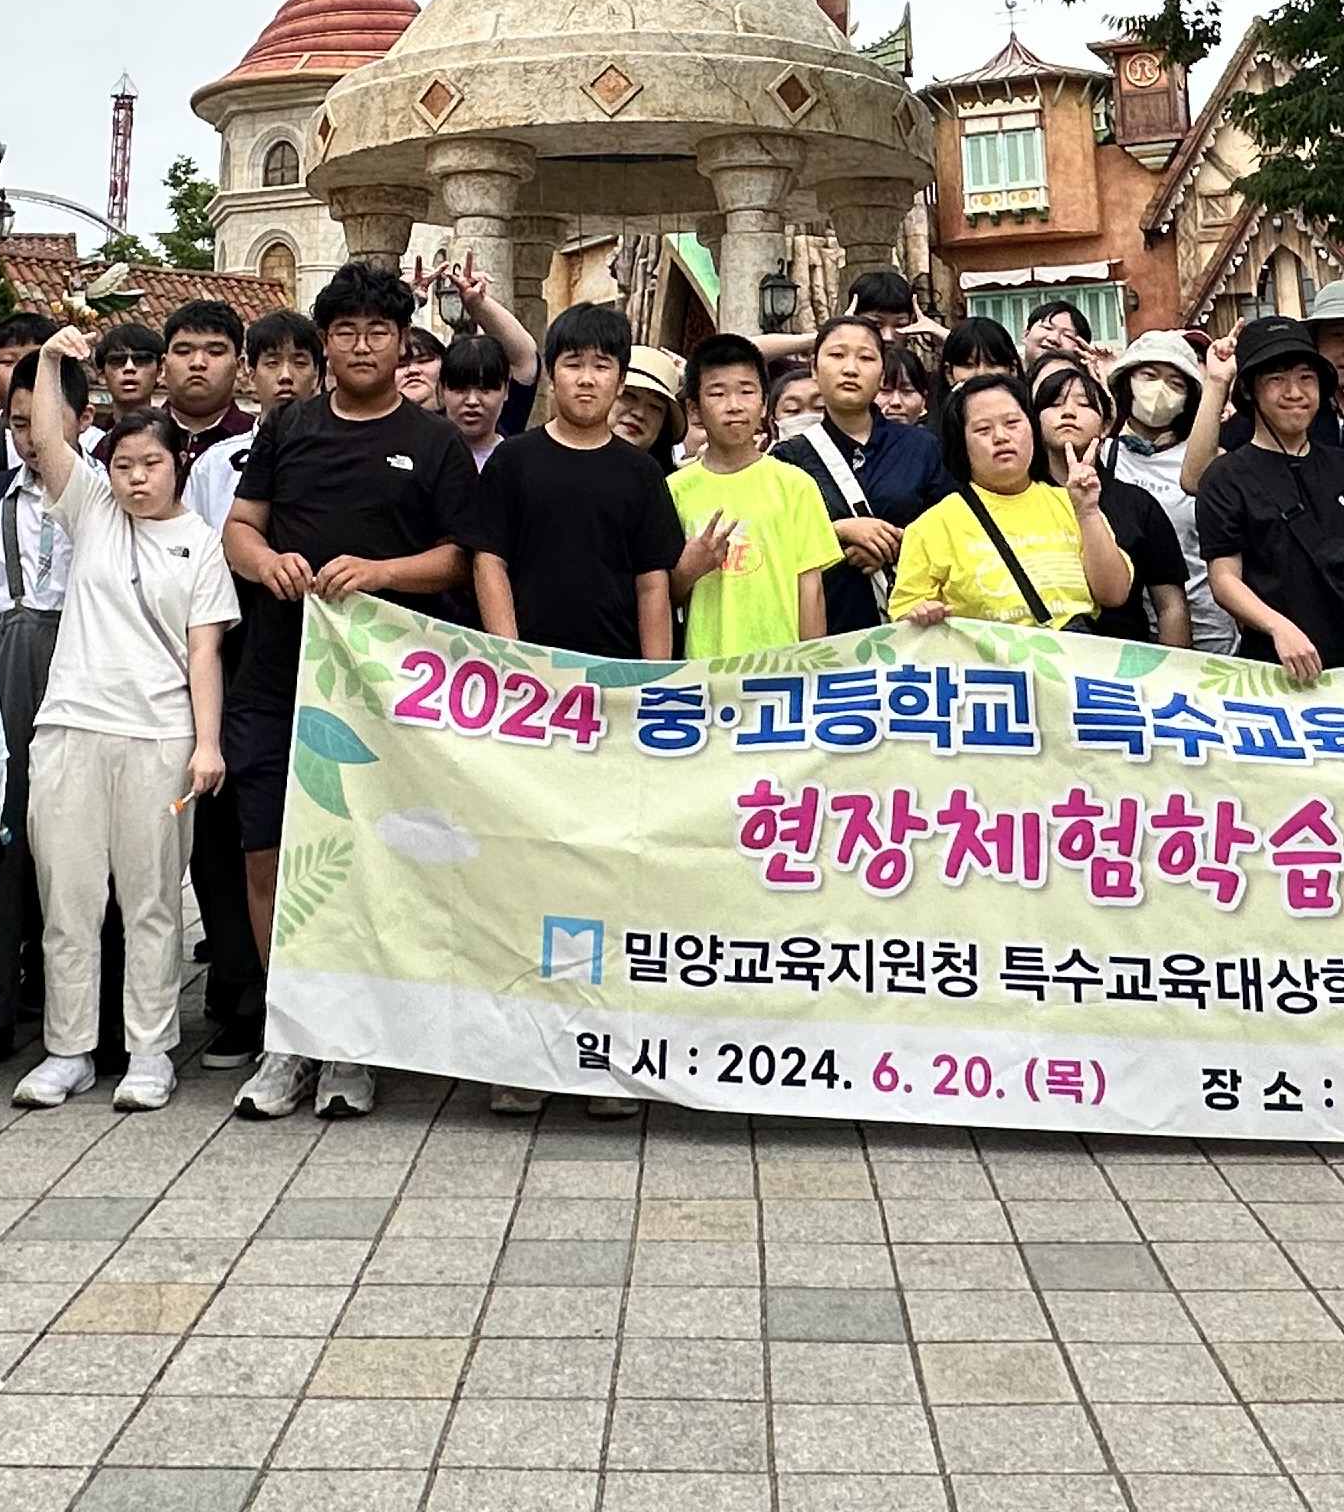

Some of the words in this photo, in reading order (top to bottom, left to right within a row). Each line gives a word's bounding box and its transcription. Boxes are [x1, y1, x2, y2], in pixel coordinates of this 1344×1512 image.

[394, 650, 601, 746] 2024
[635, 662, 1037, 752] 중·고등학교
[737, 778, 1344, 912] 현장체험학습
[624, 931, 978, 998] 밀양교육지원청
[717, 1043, 852, 1091] 2024.
[872, 1051, 913, 1092] 6.
[934, 1053, 1005, 1099] 20.
[1024, 1055, 1106, 1106] (목)
